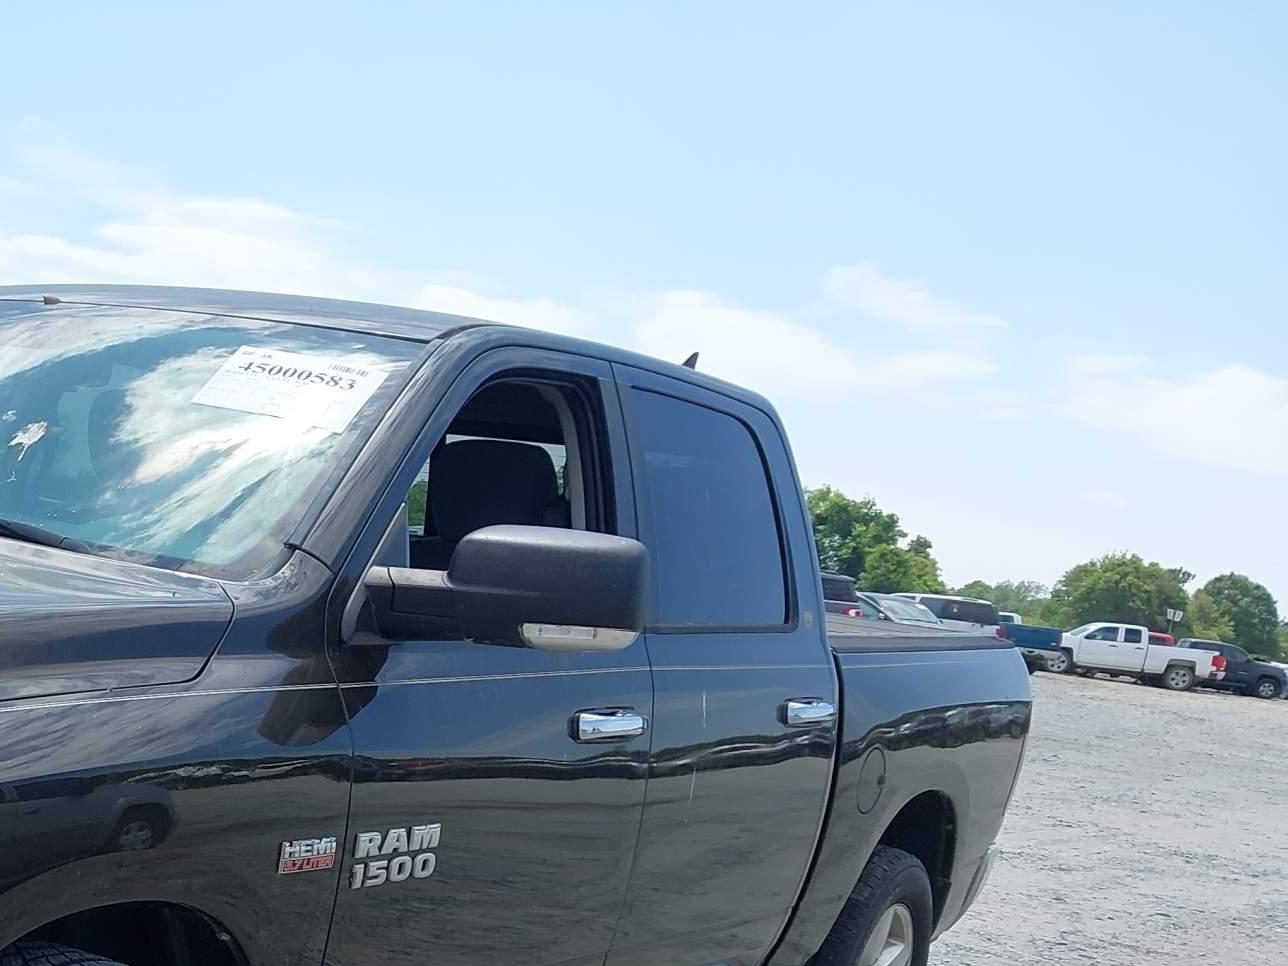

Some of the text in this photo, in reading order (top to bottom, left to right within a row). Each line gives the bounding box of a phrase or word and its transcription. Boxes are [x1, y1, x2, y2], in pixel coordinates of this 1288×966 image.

[239, 361, 357, 391] 45000583
[281, 837, 336, 858] HEMI
[354, 823, 441, 858] RAM
[352, 853, 436, 888] 1500
